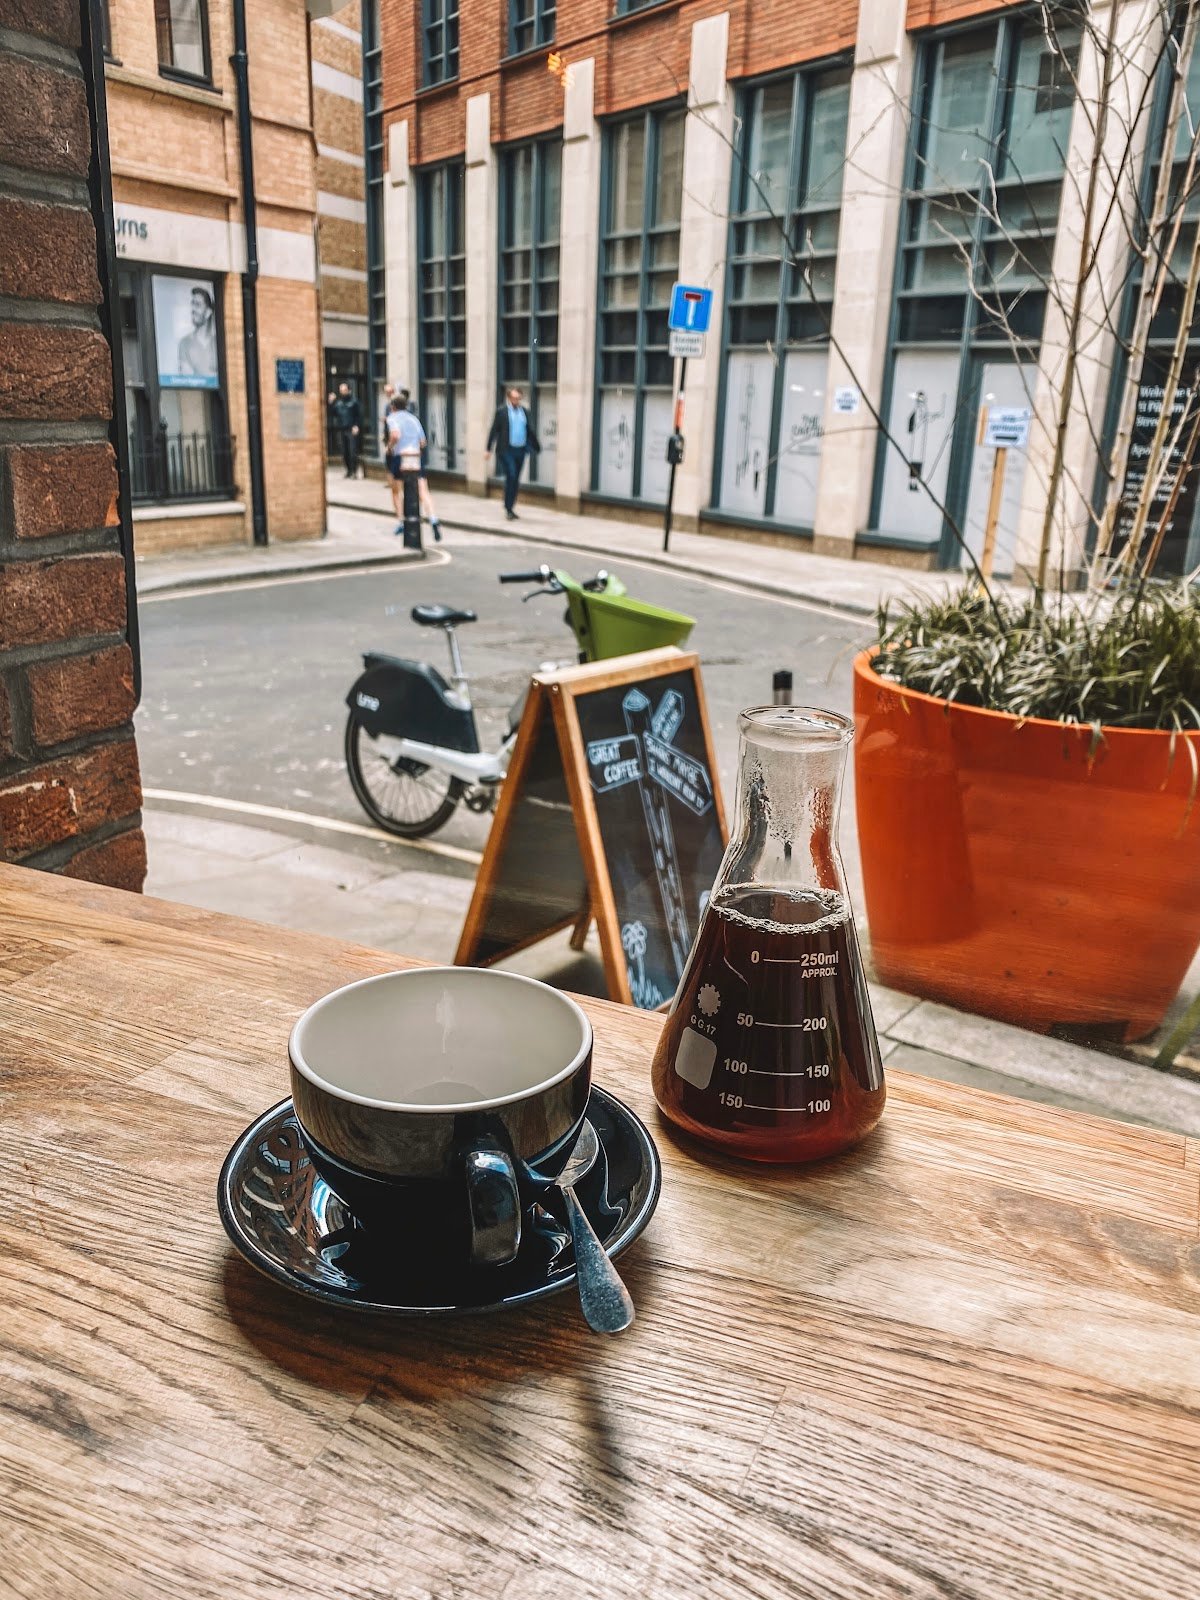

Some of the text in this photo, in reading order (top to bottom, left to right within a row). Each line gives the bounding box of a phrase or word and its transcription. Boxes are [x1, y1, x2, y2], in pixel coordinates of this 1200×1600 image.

[588, 743, 620, 765] GREAT
[603, 758, 641, 783] COFFEE
[750, 950, 839, 967] 0 250ml
[801, 967, 838, 979] APPROX.
[736, 1012, 828, 1032] 50 200
[723, 1058, 830, 1079] 100 150
[718, 1091, 831, 1114] 150 100
